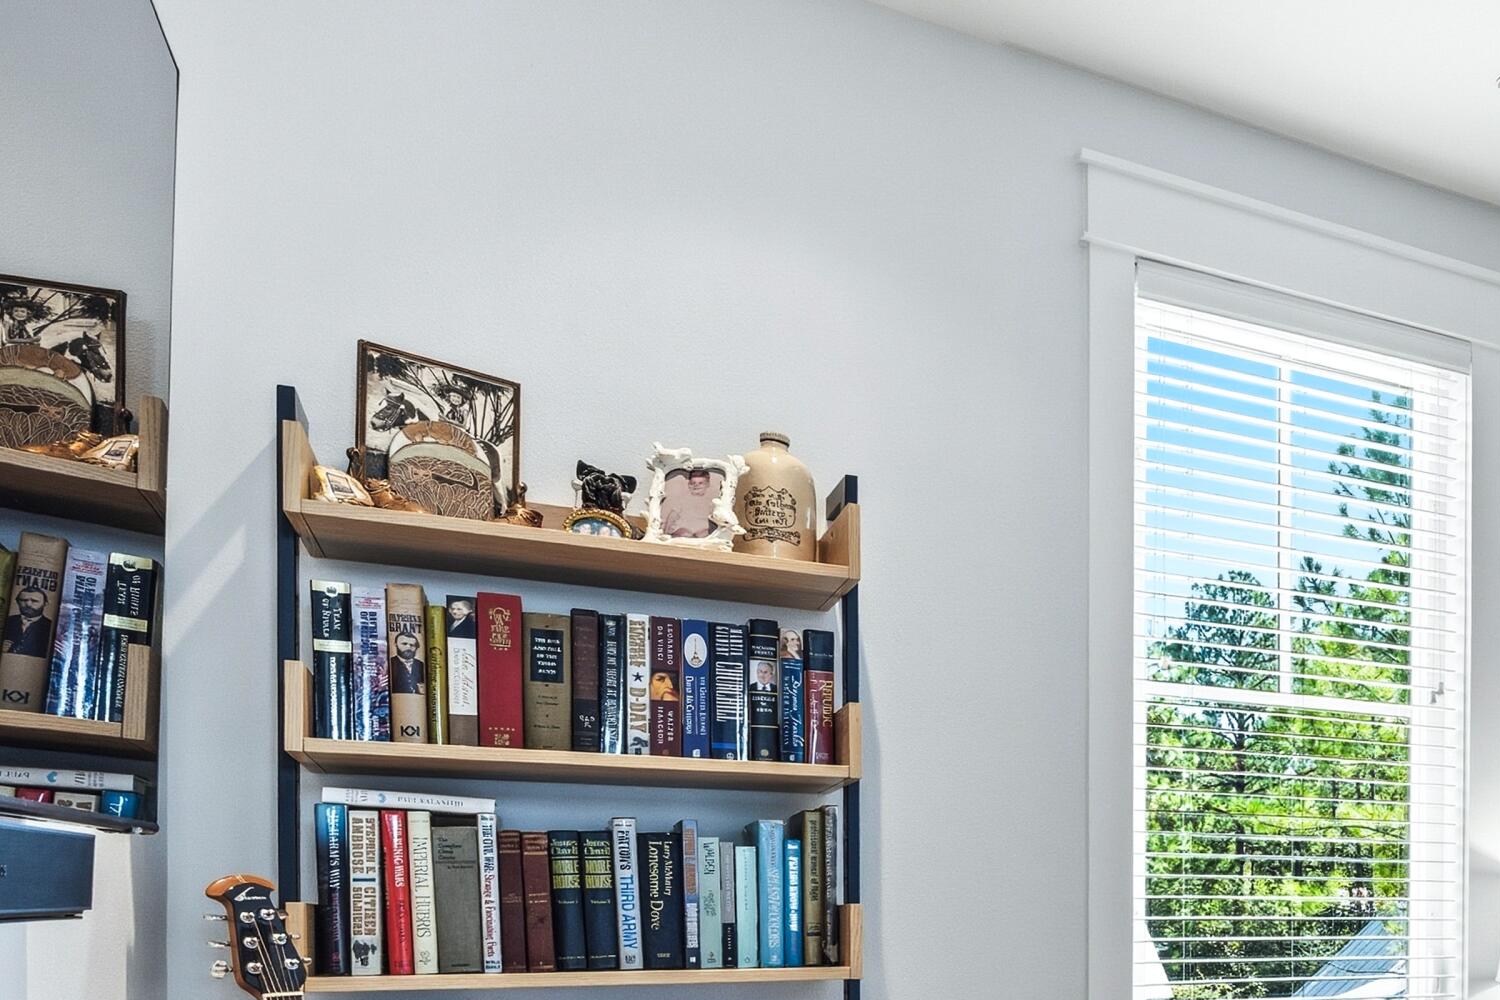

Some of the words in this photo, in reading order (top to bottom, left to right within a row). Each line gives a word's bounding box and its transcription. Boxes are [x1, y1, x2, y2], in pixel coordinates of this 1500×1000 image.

[389, 621, 422, 634] GRANT
[666, 623, 675, 665] LEONARDO
[629, 687, 647, 734] D-DAY
[715, 661, 744, 723] CHURCHILL
[352, 817, 363, 875] AMBROSE
[365, 817, 377, 862] STEPHEN
[617, 829, 632, 871] PATTON'S
[663, 841, 673, 859] Larry
[413, 837, 430, 893] IMPERIAL
[649, 841, 662, 898] Lonesome
[352, 886, 363, 936] SOLDIERS
[364, 887, 377, 936] CITIZEN
[620, 874, 637, 913] THIRD
[415, 894, 433, 939] HUBRIS
[623, 914, 639, 949] ARMY
[651, 900, 664, 937] Dove
